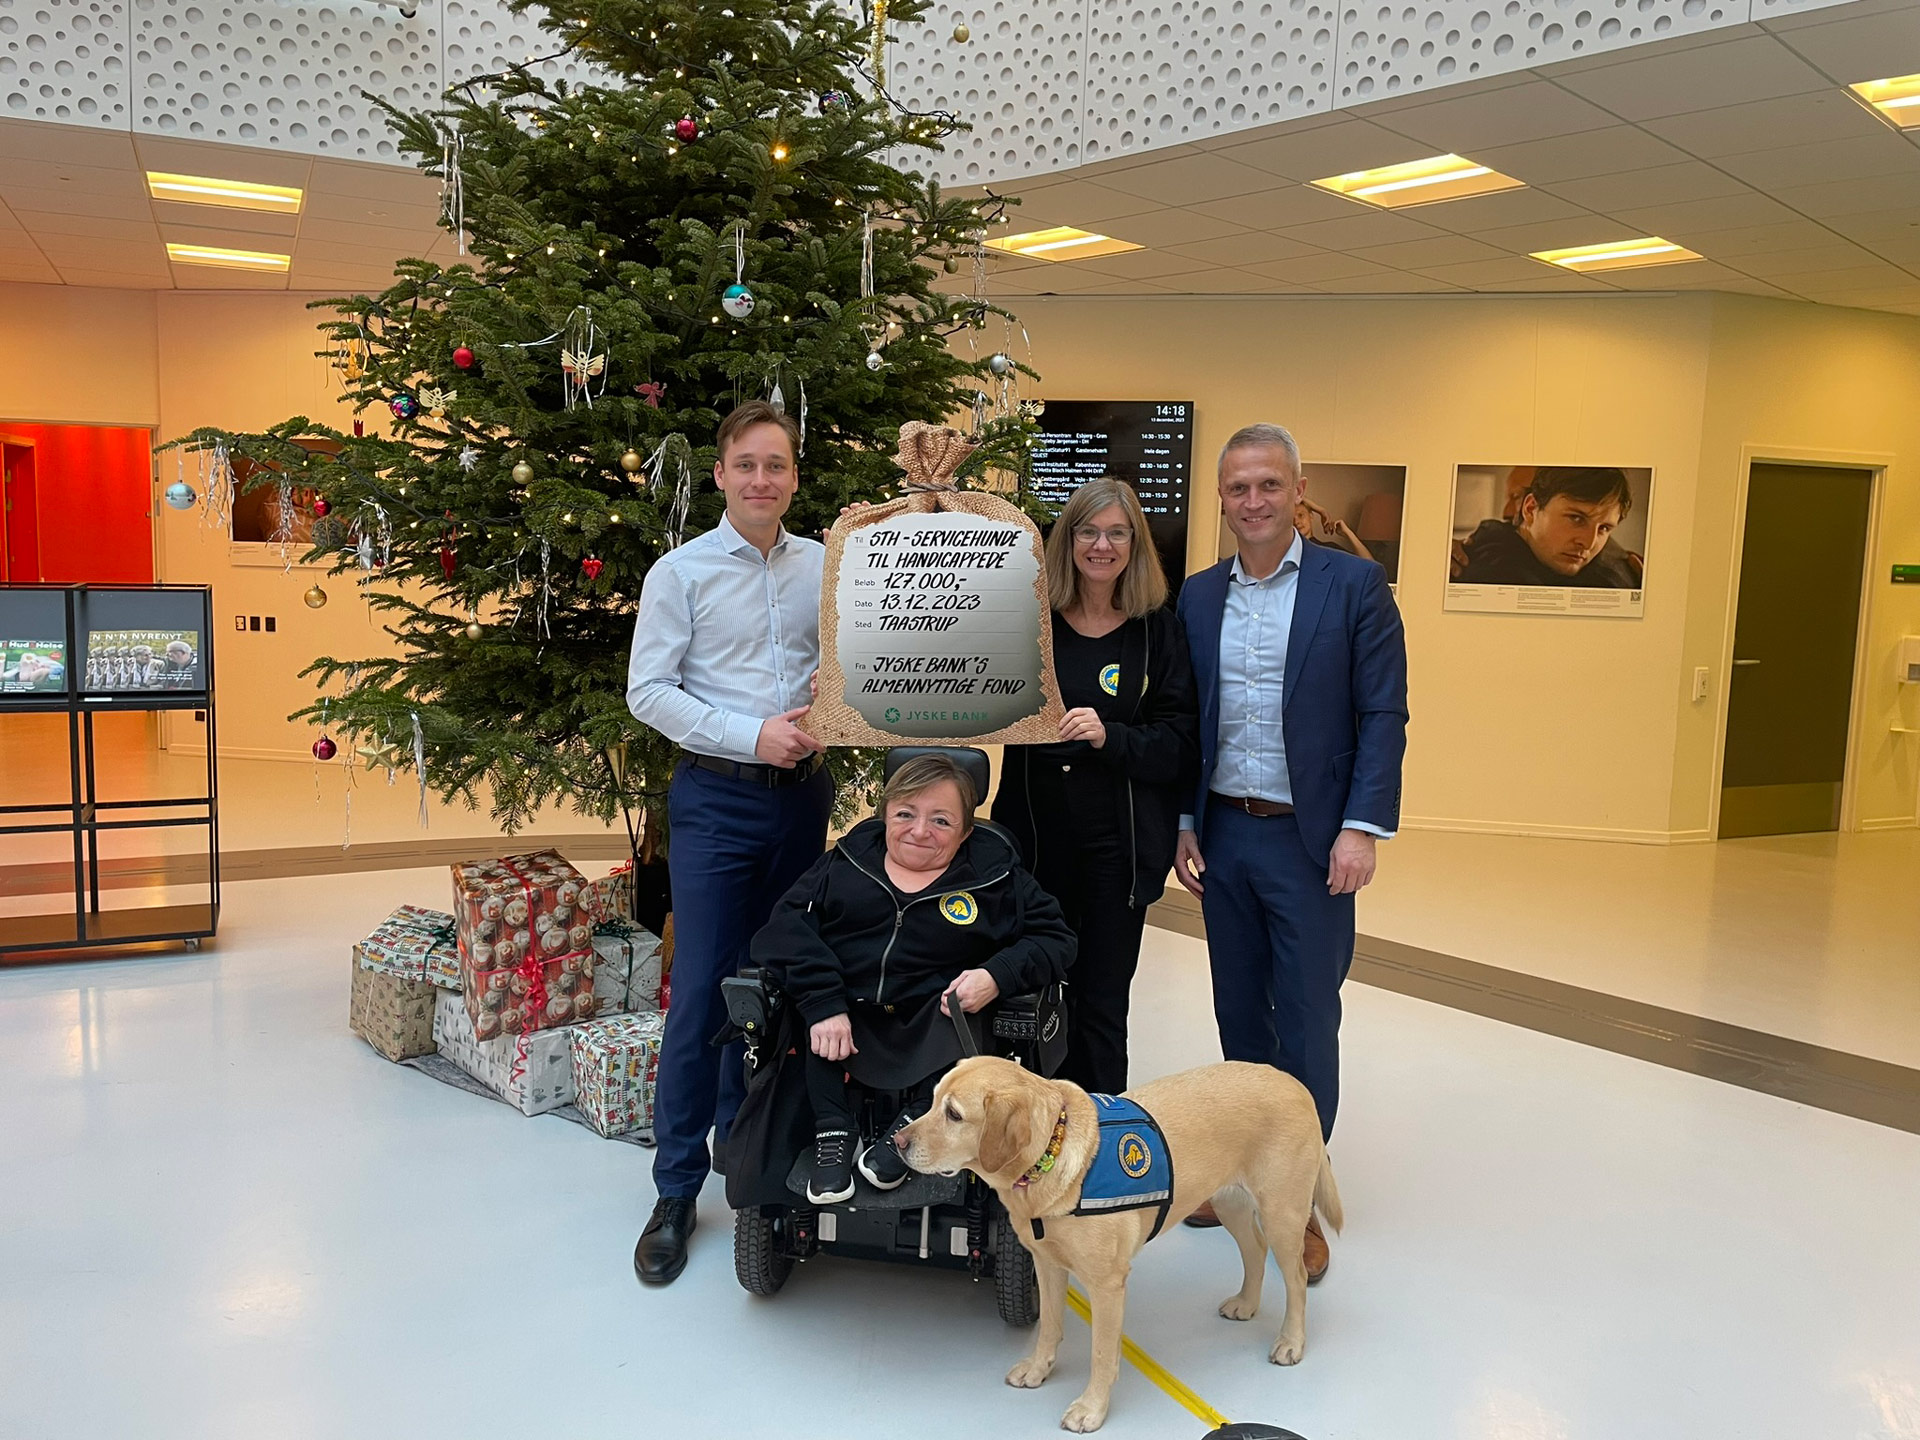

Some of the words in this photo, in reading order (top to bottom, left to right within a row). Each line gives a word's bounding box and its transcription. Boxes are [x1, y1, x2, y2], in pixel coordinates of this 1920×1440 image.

[1156, 405, 1185, 416] 14:18
[870, 531, 901, 547] STH
[911, 530, 1022, 547] SERVICEHUNDE
[868, 553, 889, 568] TIL
[895, 552, 1010, 569] HANDICAPPEDE
[883, 572, 968, 592] 127.000,-
[880, 594, 981, 610] 13.12.2023
[879, 615, 959, 631] TAASTRUP
[131, 632, 182, 640] NYRENYT
[873, 657, 925, 672] JYSKE
[925, 656, 989, 674] BANK'S
[861, 678, 978, 694] ALMENNYTTIGE
[981, 679, 1026, 695] FOND
[906, 712, 947, 720] JYSKE
[952, 712, 988, 720] BANK
